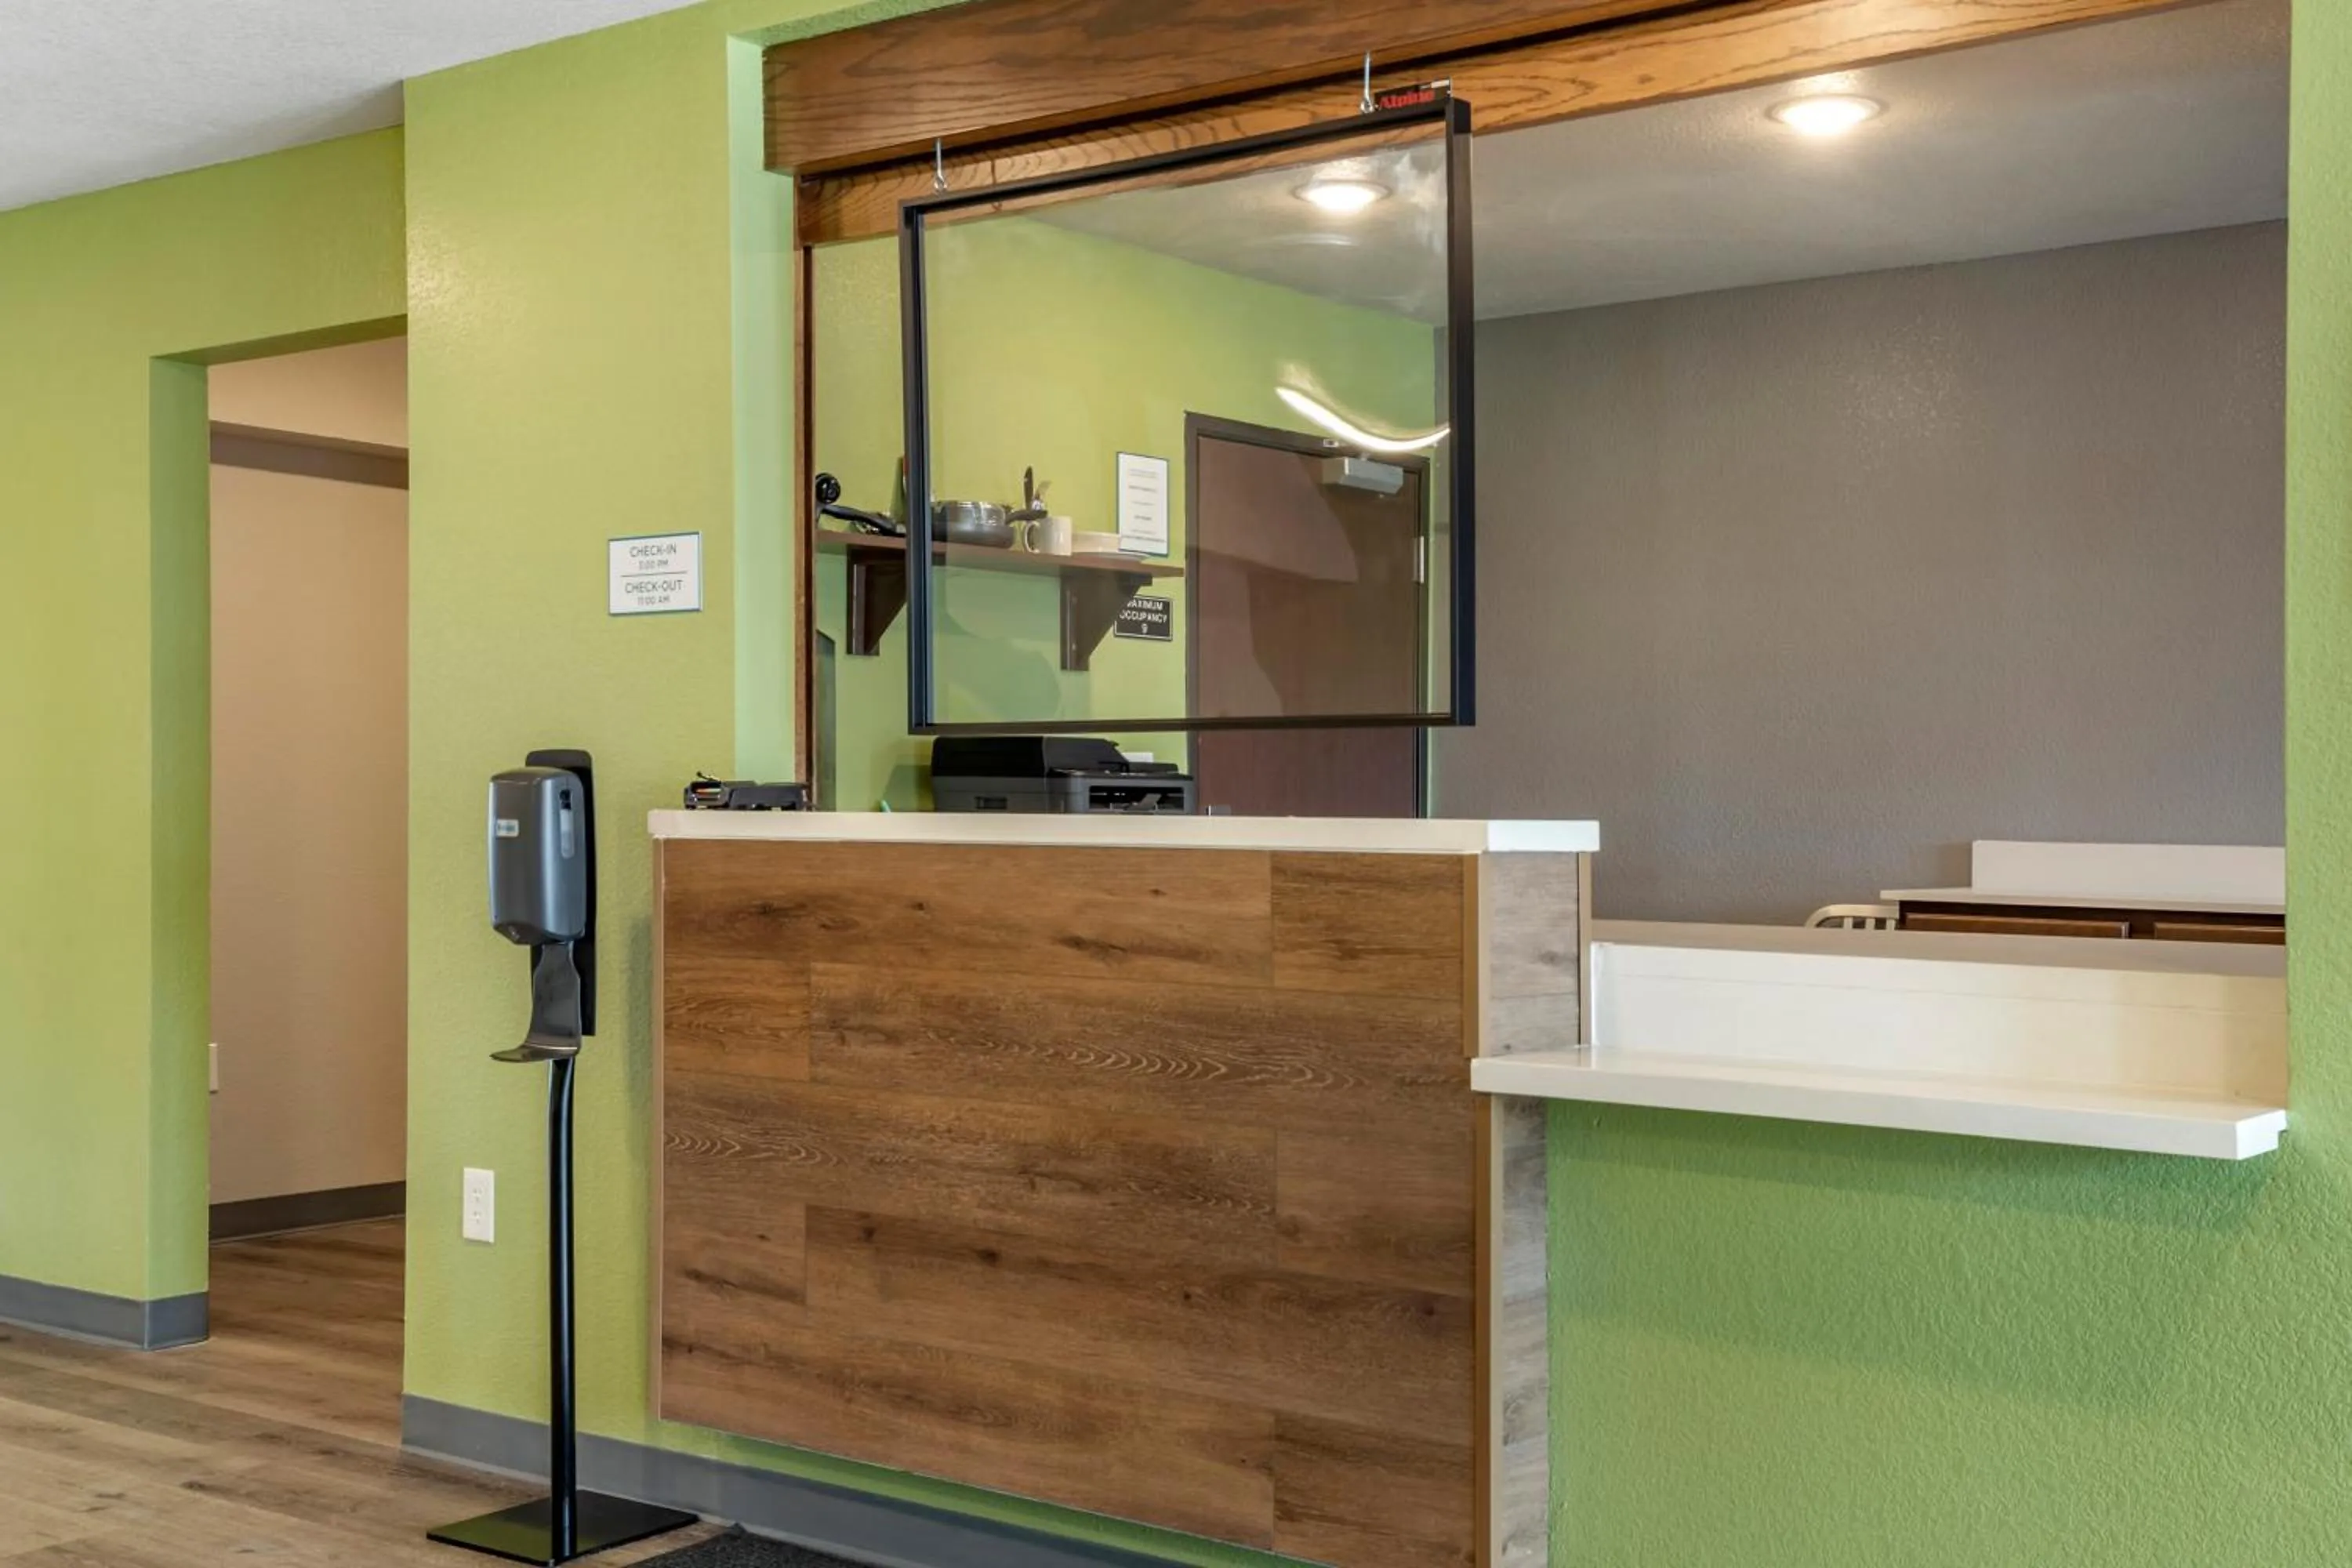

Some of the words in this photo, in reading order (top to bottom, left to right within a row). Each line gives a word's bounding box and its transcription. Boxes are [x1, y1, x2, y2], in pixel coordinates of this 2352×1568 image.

[629, 543, 677, 557] CHECK-IN
[625, 579, 683, 593] CHECK-OUT
[659, 594, 670, 604] AM
